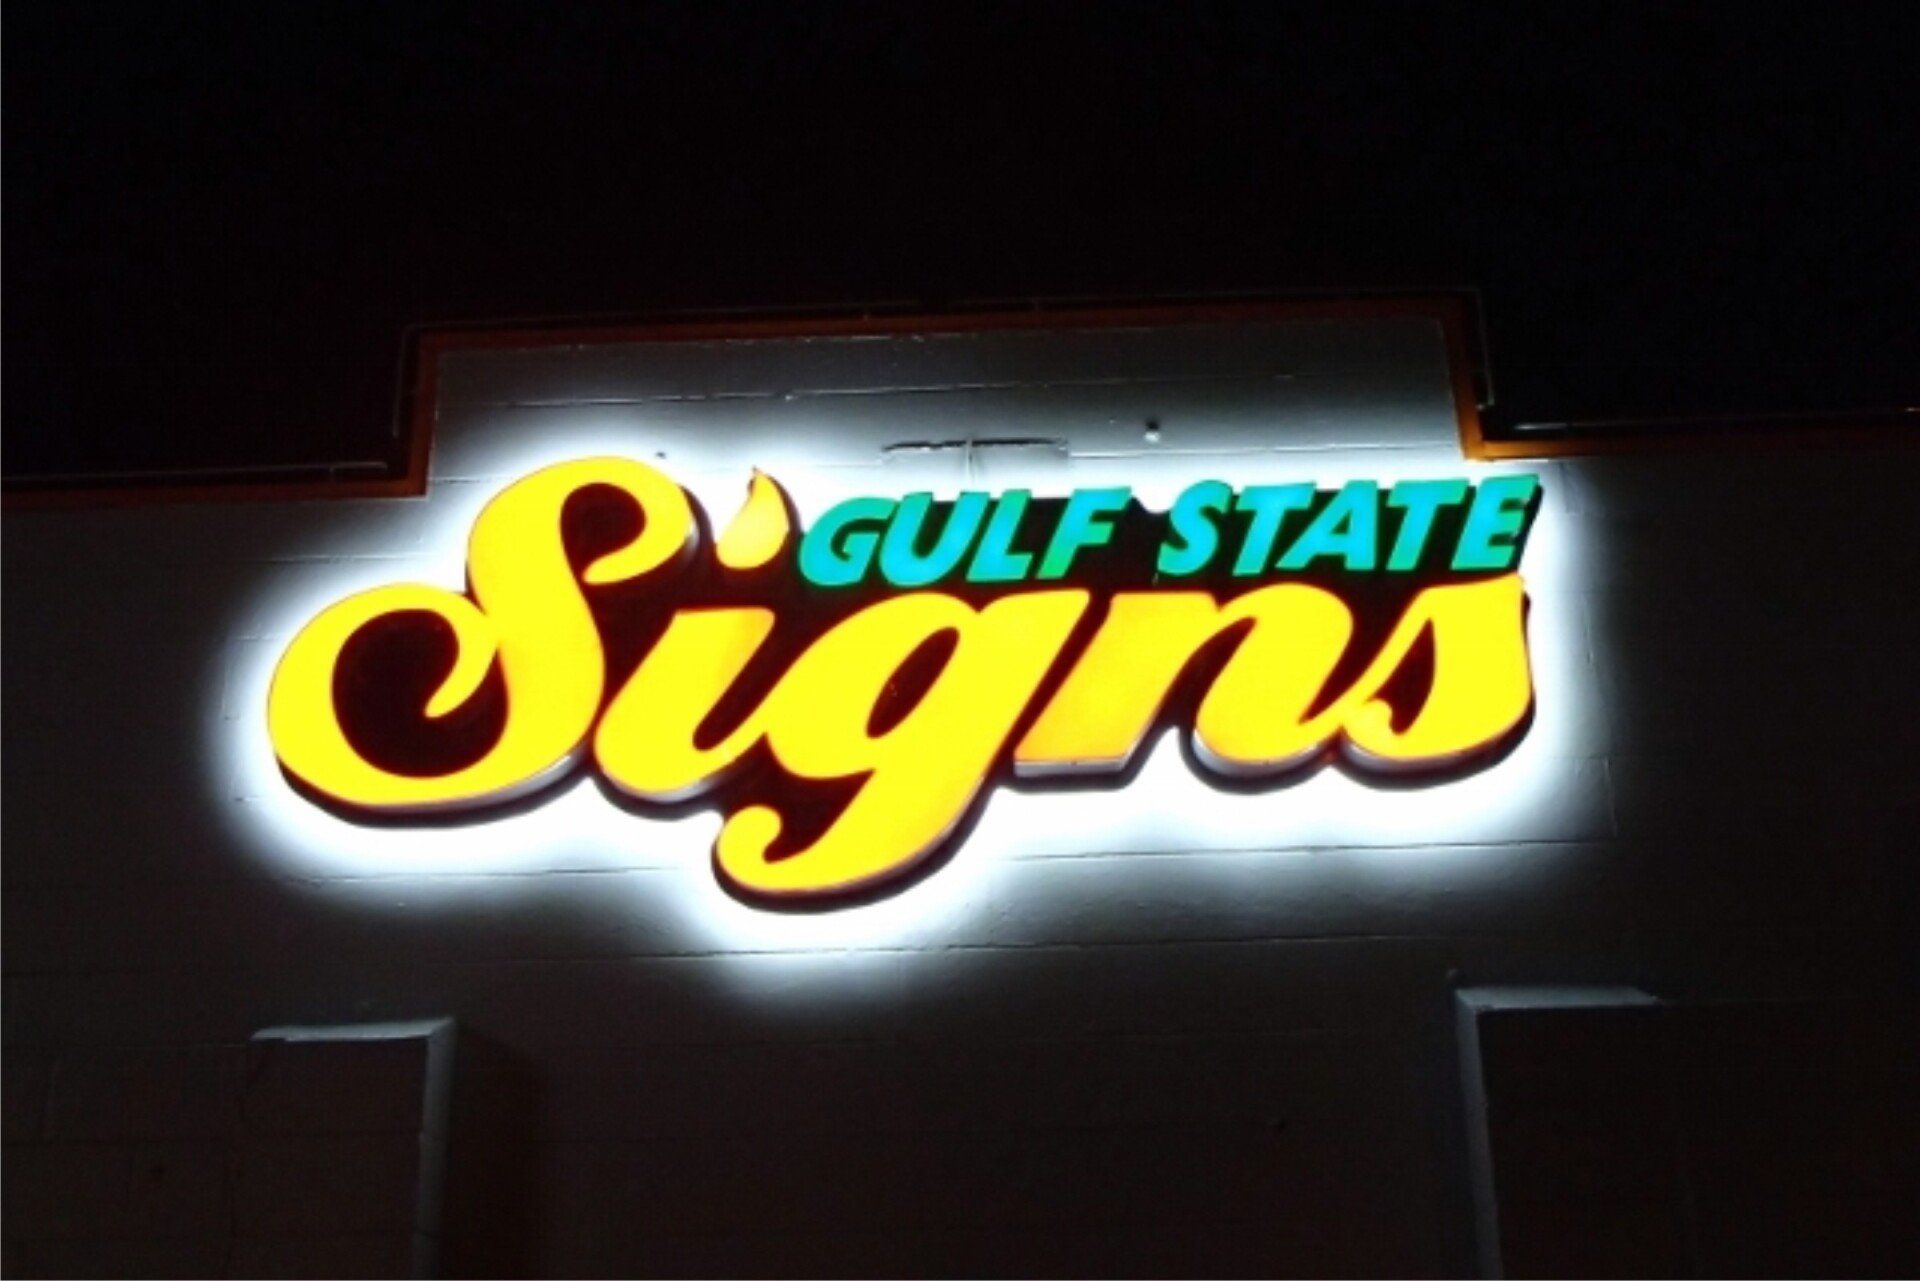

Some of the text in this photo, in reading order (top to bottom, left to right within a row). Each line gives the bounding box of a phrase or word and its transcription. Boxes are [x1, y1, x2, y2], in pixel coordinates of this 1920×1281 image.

[799, 474, 1540, 586] GULF STATE
[267, 456, 1534, 893] Signs
